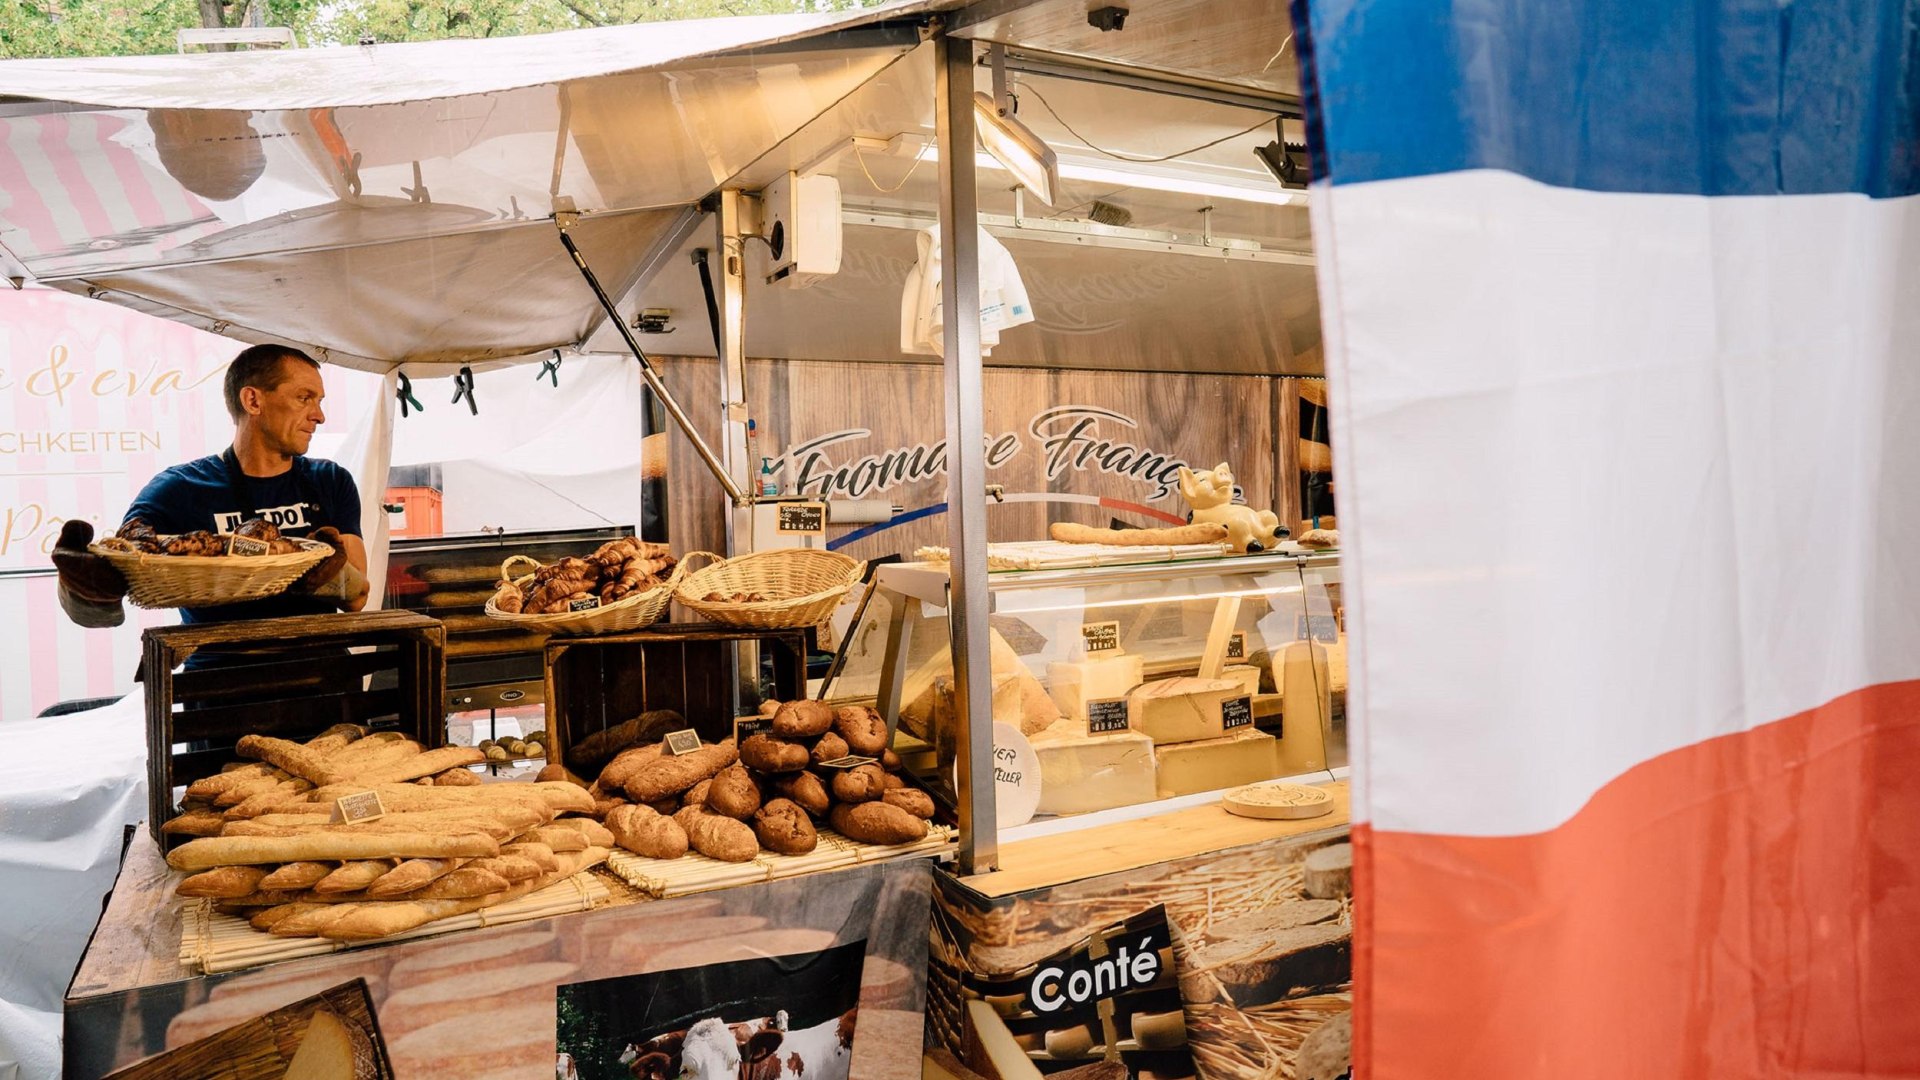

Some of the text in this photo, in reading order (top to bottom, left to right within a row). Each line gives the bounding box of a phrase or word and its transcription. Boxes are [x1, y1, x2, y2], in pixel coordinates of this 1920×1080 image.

[26, 345, 81, 407] &
[91, 359, 230, 397] eva
[770, 430, 1018, 501] Fromae
[1031, 936, 1158, 1012] Conté
